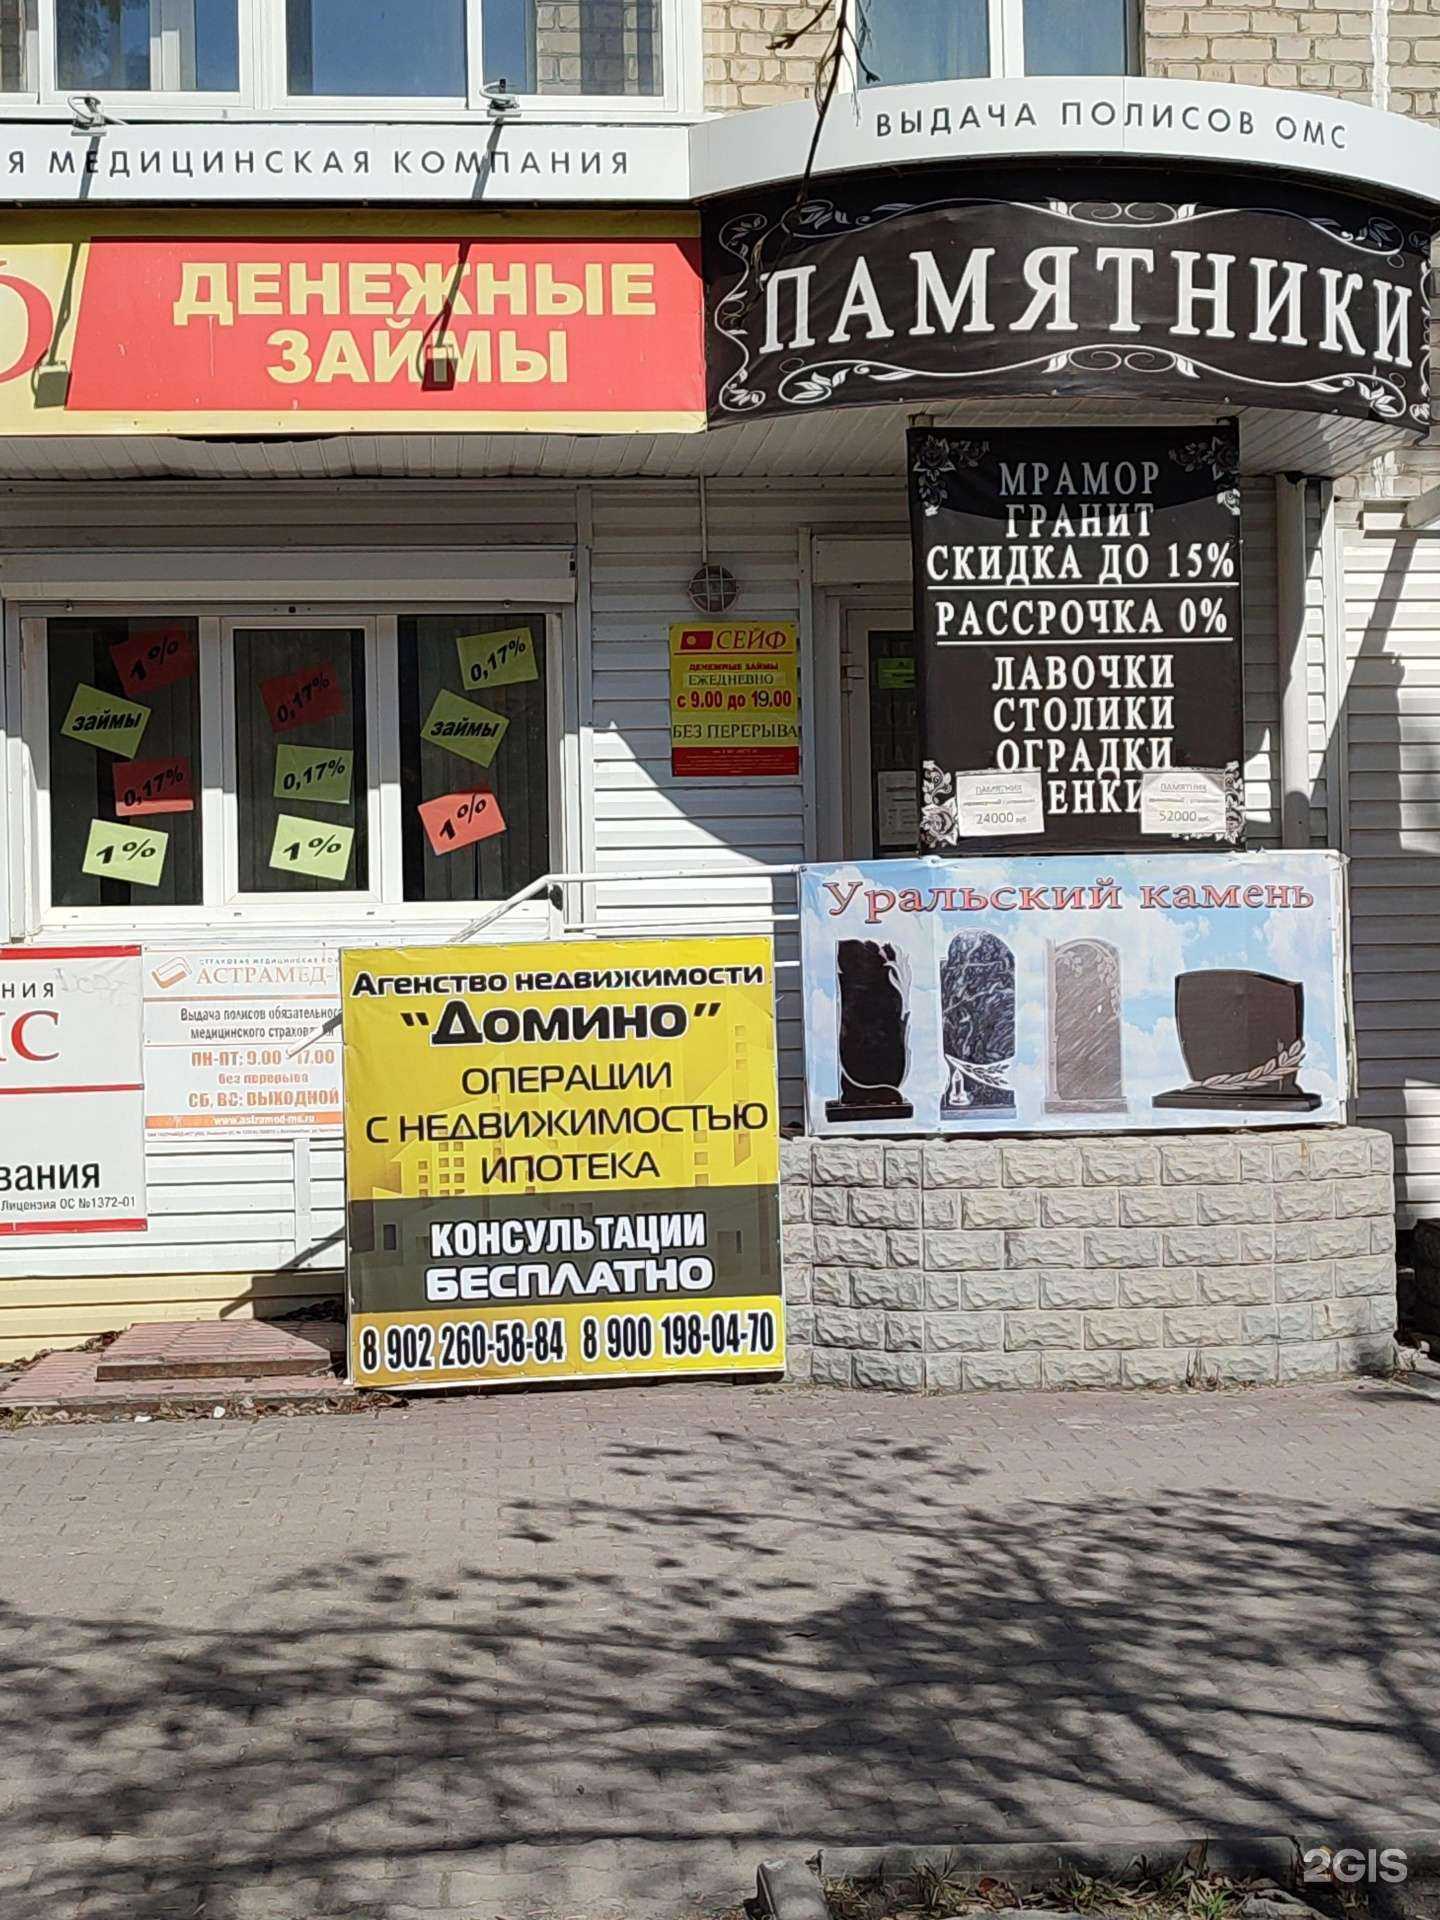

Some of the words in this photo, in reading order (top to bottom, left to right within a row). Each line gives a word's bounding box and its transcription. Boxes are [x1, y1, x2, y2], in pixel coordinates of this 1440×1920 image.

[876, 101, 1037, 138] ВЫДАЧА
[1061, 101, 1256, 136] ПОЛИСОВ
[1275, 116, 1347, 149] ОМС
[8, 153, 26, 174] Я
[49, 149, 370, 178] МЕДИЦИНСКАЯ
[393, 149, 628, 174] КОМПАНИЯ
[172, 262, 657, 327] ДЕНЕЖНЫЕ
[758, 245, 1414, 369] ПАМЯТНИКИ
[266, 317, 568, 384] ЗАЙМЫ
[1000, 461, 1160, 496] МРАМОР
[1005, 503, 1155, 539] ГРАНИТ
[926, 544, 1083, 586] СКИДКА
[1098, 543, 1150, 585] ДО
[1168, 541, 1236, 580] 15%
[935, 600, 1164, 637] РАССРОЧКА
[1178, 598, 1229, 634] 0%
[716, 628, 786, 650] СЕЙФ
[128, 636, 179, 681] 1%
[471, 635, 528, 682] 0,17%
[992, 654, 1176, 692] ЛАВОЧКИ
[688, 674, 774, 685] ЕЖЕДНЕВНО
[276, 671, 331, 724] 0,17%
[690, 691, 723, 708] 9.00
[727, 694, 746, 710] до
[752, 690, 792, 707] 19.00
[993, 695, 1176, 733] СТОЛИКИ
[71, 707, 142, 733] займы
[430, 713, 499, 738] займы
[673, 725, 702, 738] БЕЗ
[707, 723, 799, 738] ПЕРЕРЫВА
[282, 757, 346, 791] 0,17%
[996, 737, 1174, 780] ОГРАДКИ
[123, 764, 184, 808] 0,17%
[1047, 779, 1143, 815] ЕНКИ
[440, 791, 488, 841] 1%
[975, 812, 1014, 825] 24000
[1159, 809, 1197, 823] 52000
[96, 838, 157, 866] 1%
[282, 833, 342, 862] 1%
[822, 877, 1122, 923] Уральский
[1140, 881, 1314, 909] камень
[2, 982, 54, 999] НИЯ
[352, 974, 507, 995] Агенство
[516, 967, 763, 991] недвижимости
[180, 1008, 221, 1021] Выдача
[224, 1008, 266, 1020] полисов
[191, 1027, 266, 1041] медицинского
[246, 1050, 281, 1066] 9.00
[461, 1062, 673, 1095] ОПЕРАЦИИ
[246, 1088, 339, 1107] ВЫХОДНОЙ
[366, 1116, 390, 1142] С
[400, 1103, 768, 1141] НЕДВИЖИМОСТЬЮ
[0, 1163, 100, 1191] вания
[481, 1152, 661, 1184] ИПОТЕКА
[1, 1199, 57, 1212] Лицензия
[60, 1197, 76, 1210] ОС
[431, 1212, 706, 1258] КОНСУЛЬТАЦИИ
[425, 1258, 714, 1302] БЕСПЛАТНО
[363, 1326, 378, 1370] 8
[387, 1324, 432, 1367] 902
[442, 1320, 564, 1366] 260-58-84
[583, 1318, 595, 1360] 8
[607, 1316, 653, 1359] 900
[661, 1312, 774, 1355] 198-04-70
